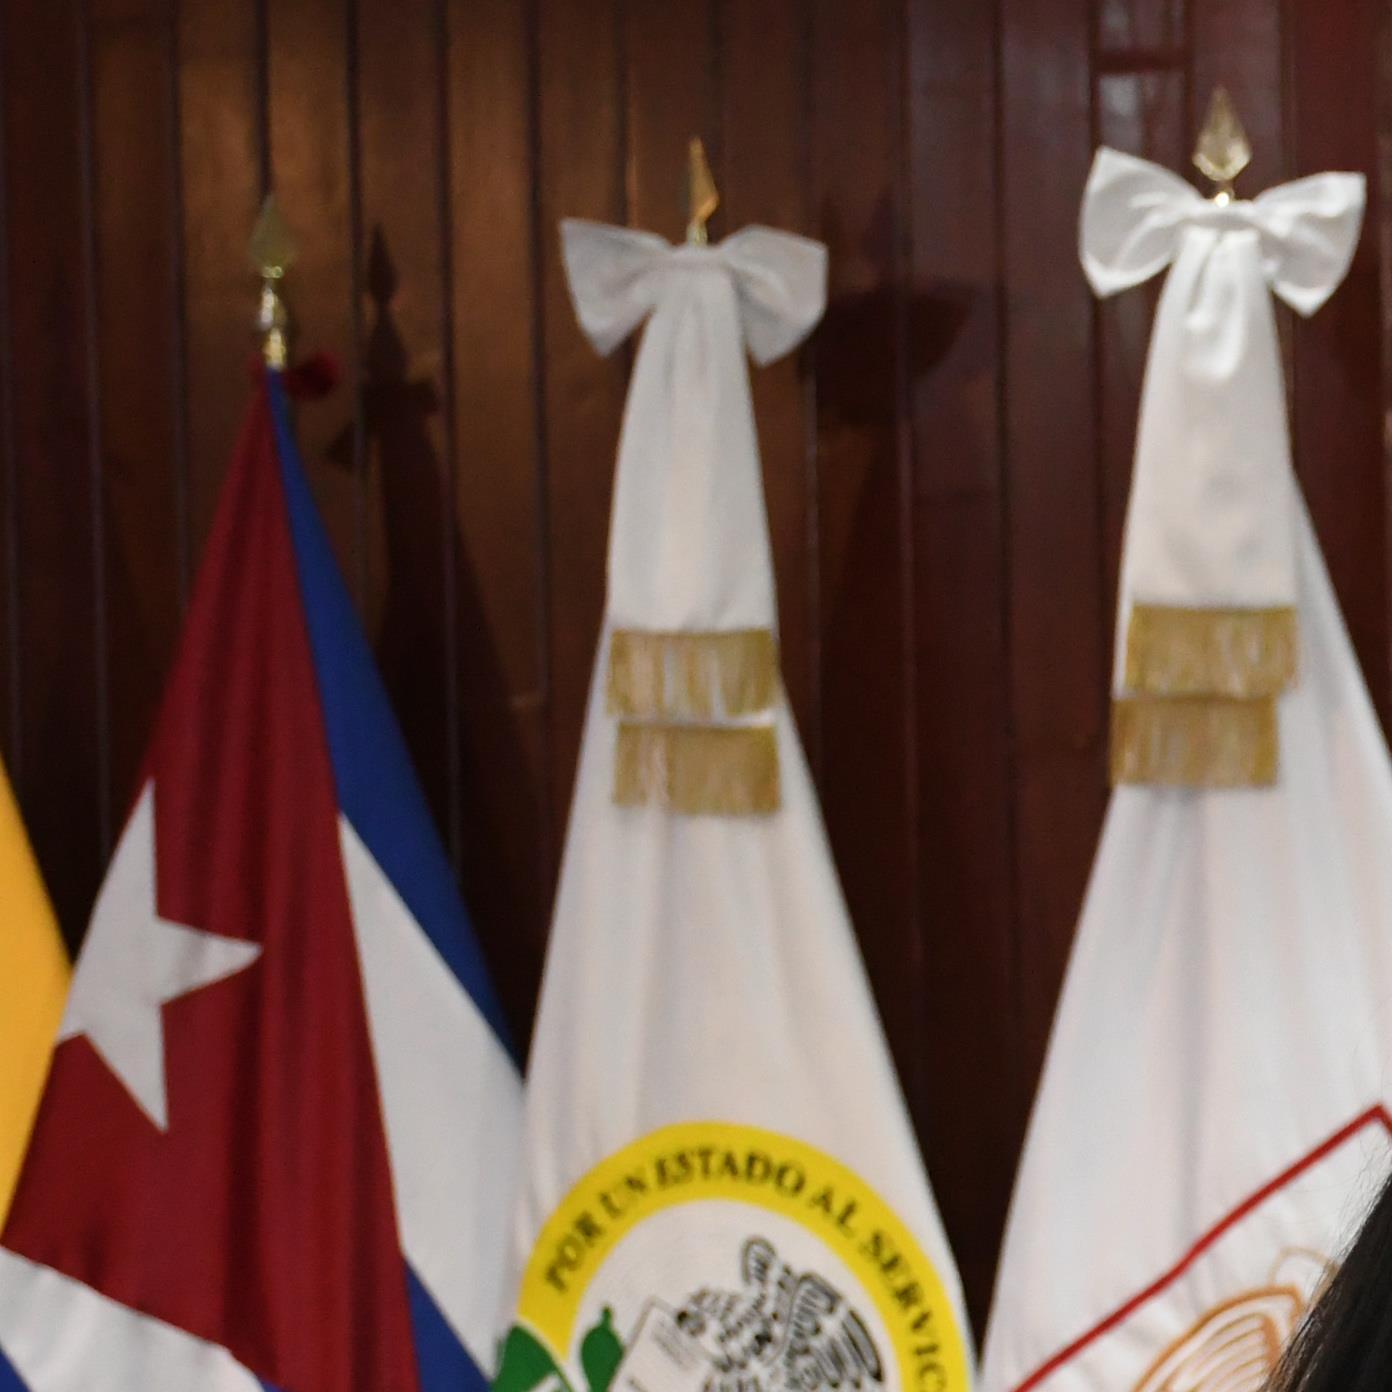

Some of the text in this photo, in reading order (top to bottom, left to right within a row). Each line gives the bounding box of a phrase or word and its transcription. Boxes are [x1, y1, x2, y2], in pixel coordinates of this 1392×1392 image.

[545, 1210, 605, 1293] POR
[654, 1147, 806, 1196] ESTADO
[808, 1186, 858, 1238] AL
